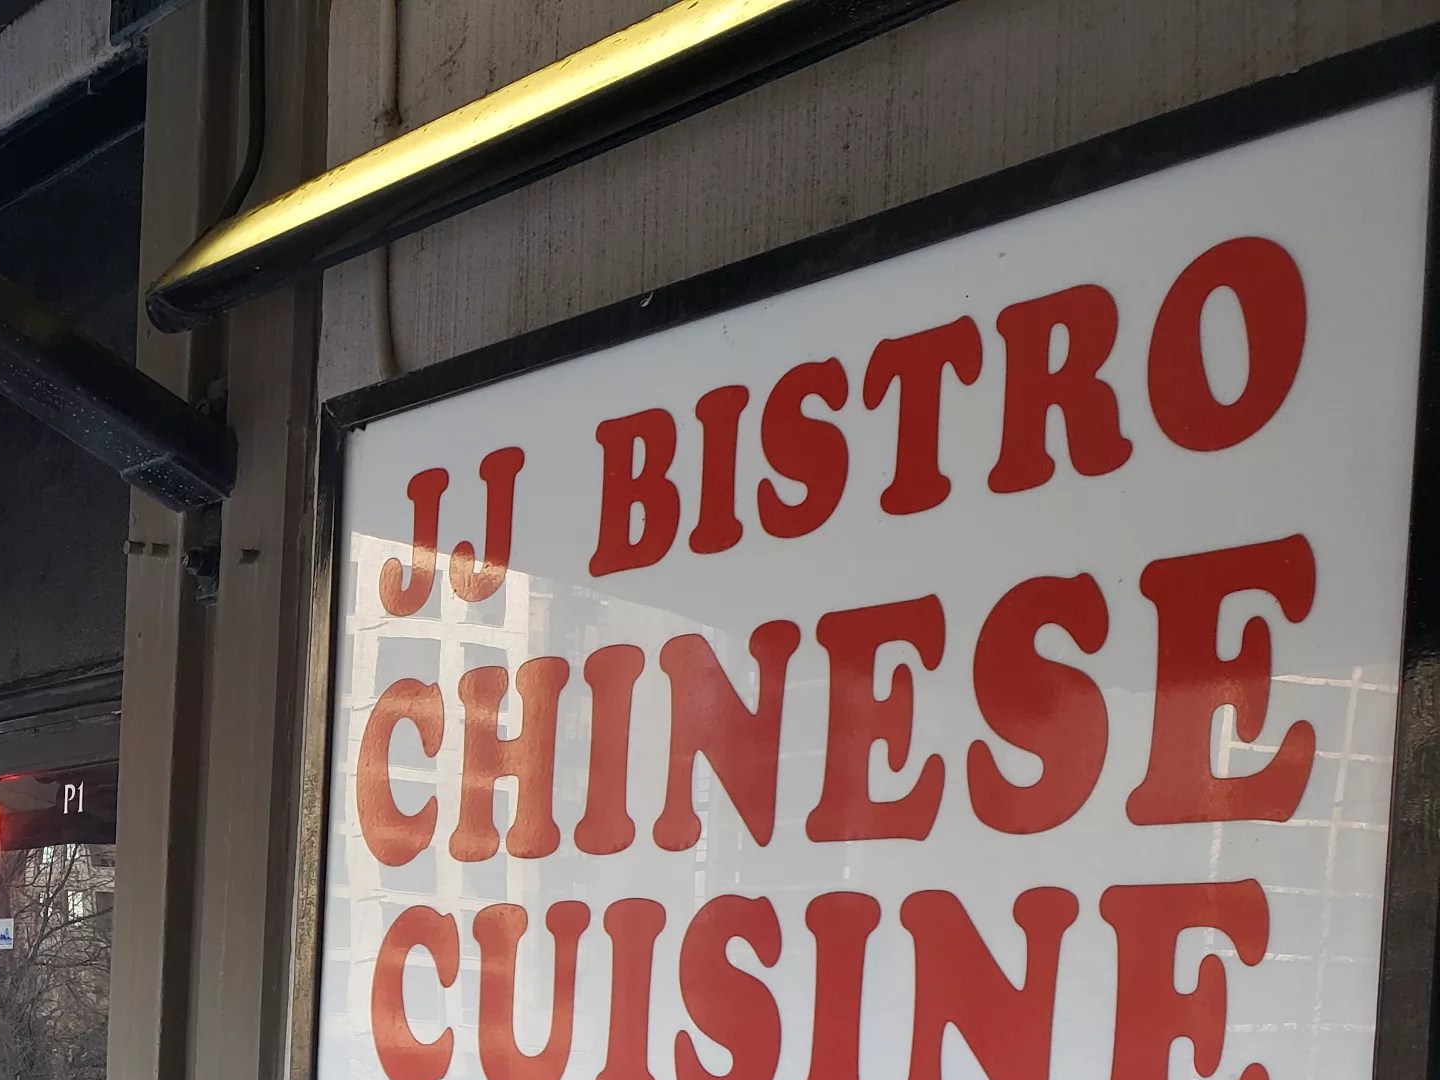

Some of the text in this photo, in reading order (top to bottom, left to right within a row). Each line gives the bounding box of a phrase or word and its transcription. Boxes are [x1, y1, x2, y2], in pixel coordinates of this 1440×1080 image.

[378, 236, 1308, 617] JJ BISTRO
[63, 780, 84, 815] P1
[357, 534, 1317, 867] CHINESE
